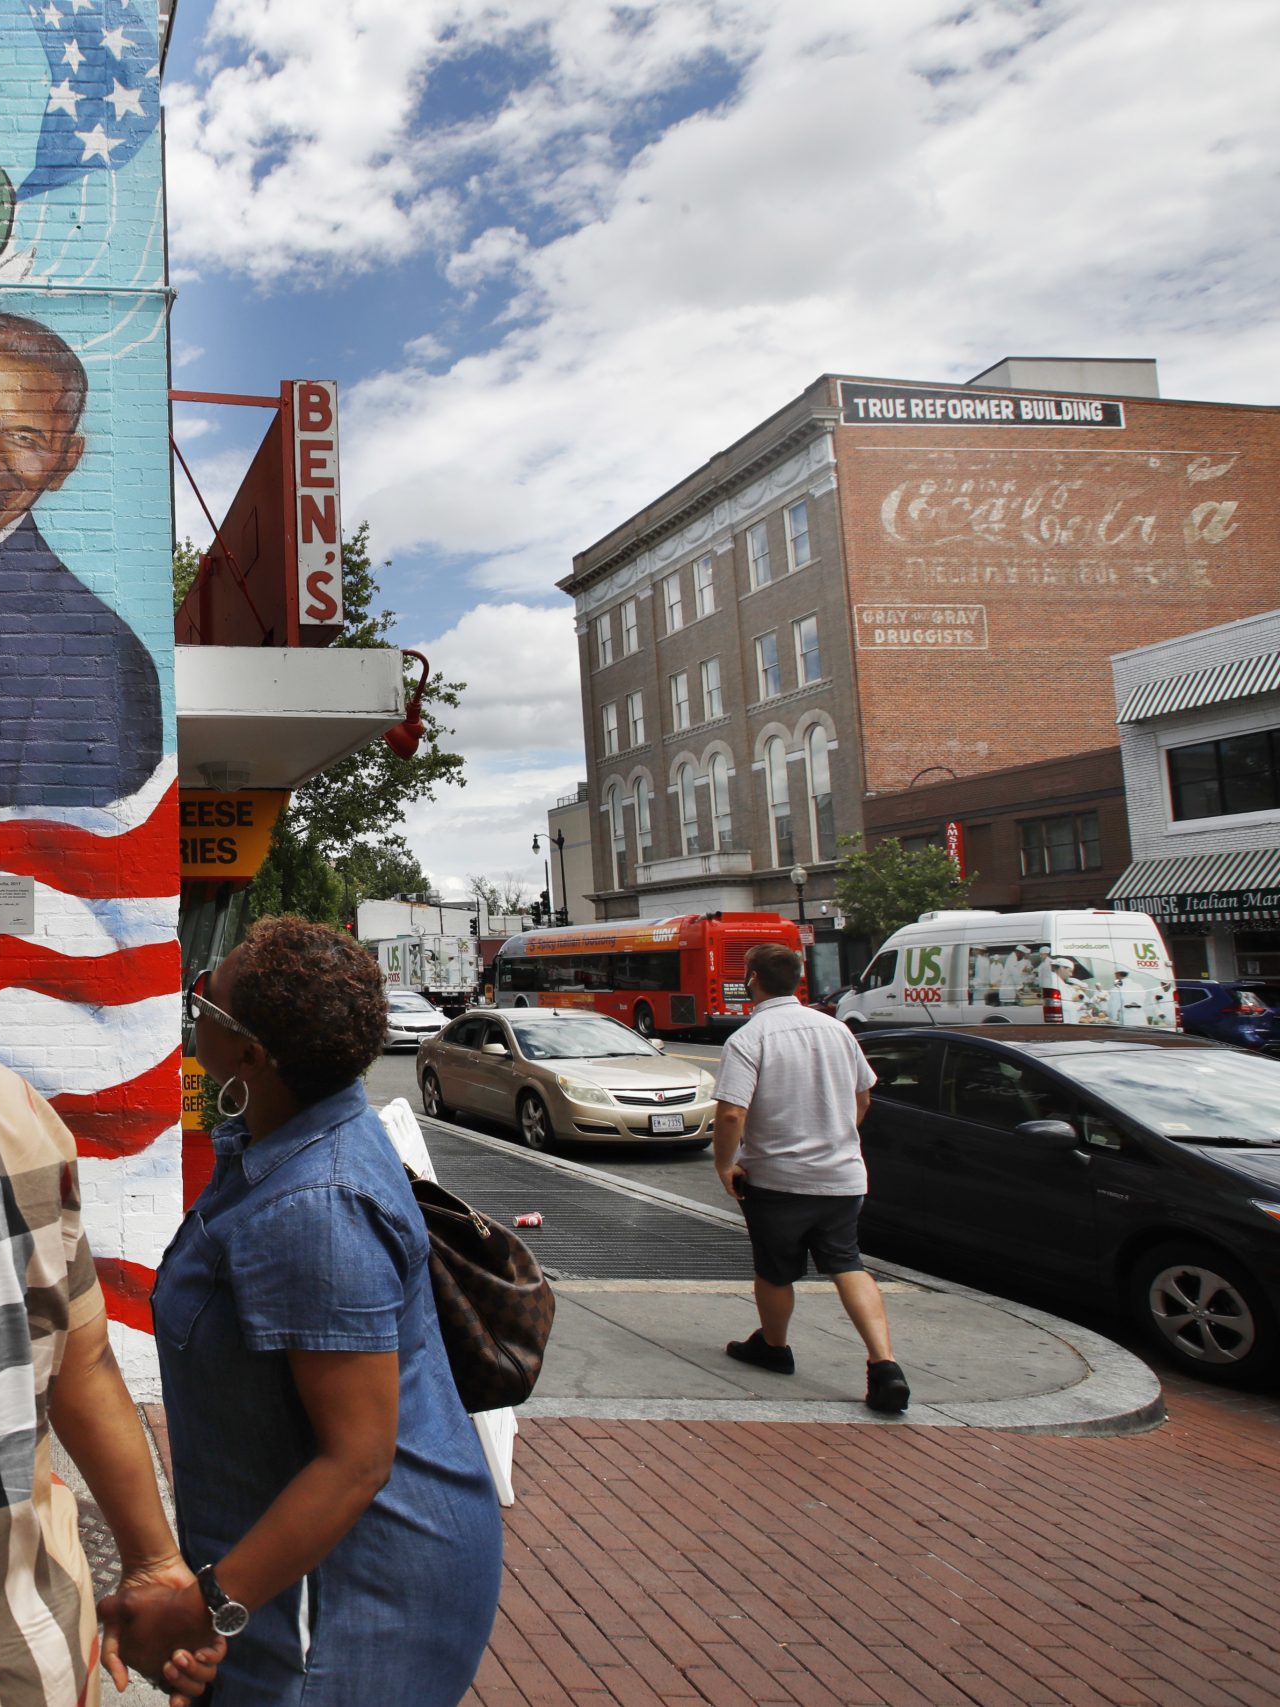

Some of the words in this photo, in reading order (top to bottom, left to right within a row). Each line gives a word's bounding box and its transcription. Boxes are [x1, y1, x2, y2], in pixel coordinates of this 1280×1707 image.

[853, 398, 907, 418] TRUE
[910, 399, 1015, 420] REFORMER
[1019, 400, 1104, 421] BUILDING
[298, 384, 338, 621] BEN'S
[862, 610, 908, 624] GRAY
[931, 610, 978, 624] GRAY
[874, 629, 974, 643] DRUGGISTS
[1184, 893, 1239, 911] Italian
[904, 987, 942, 1003] FOODS
